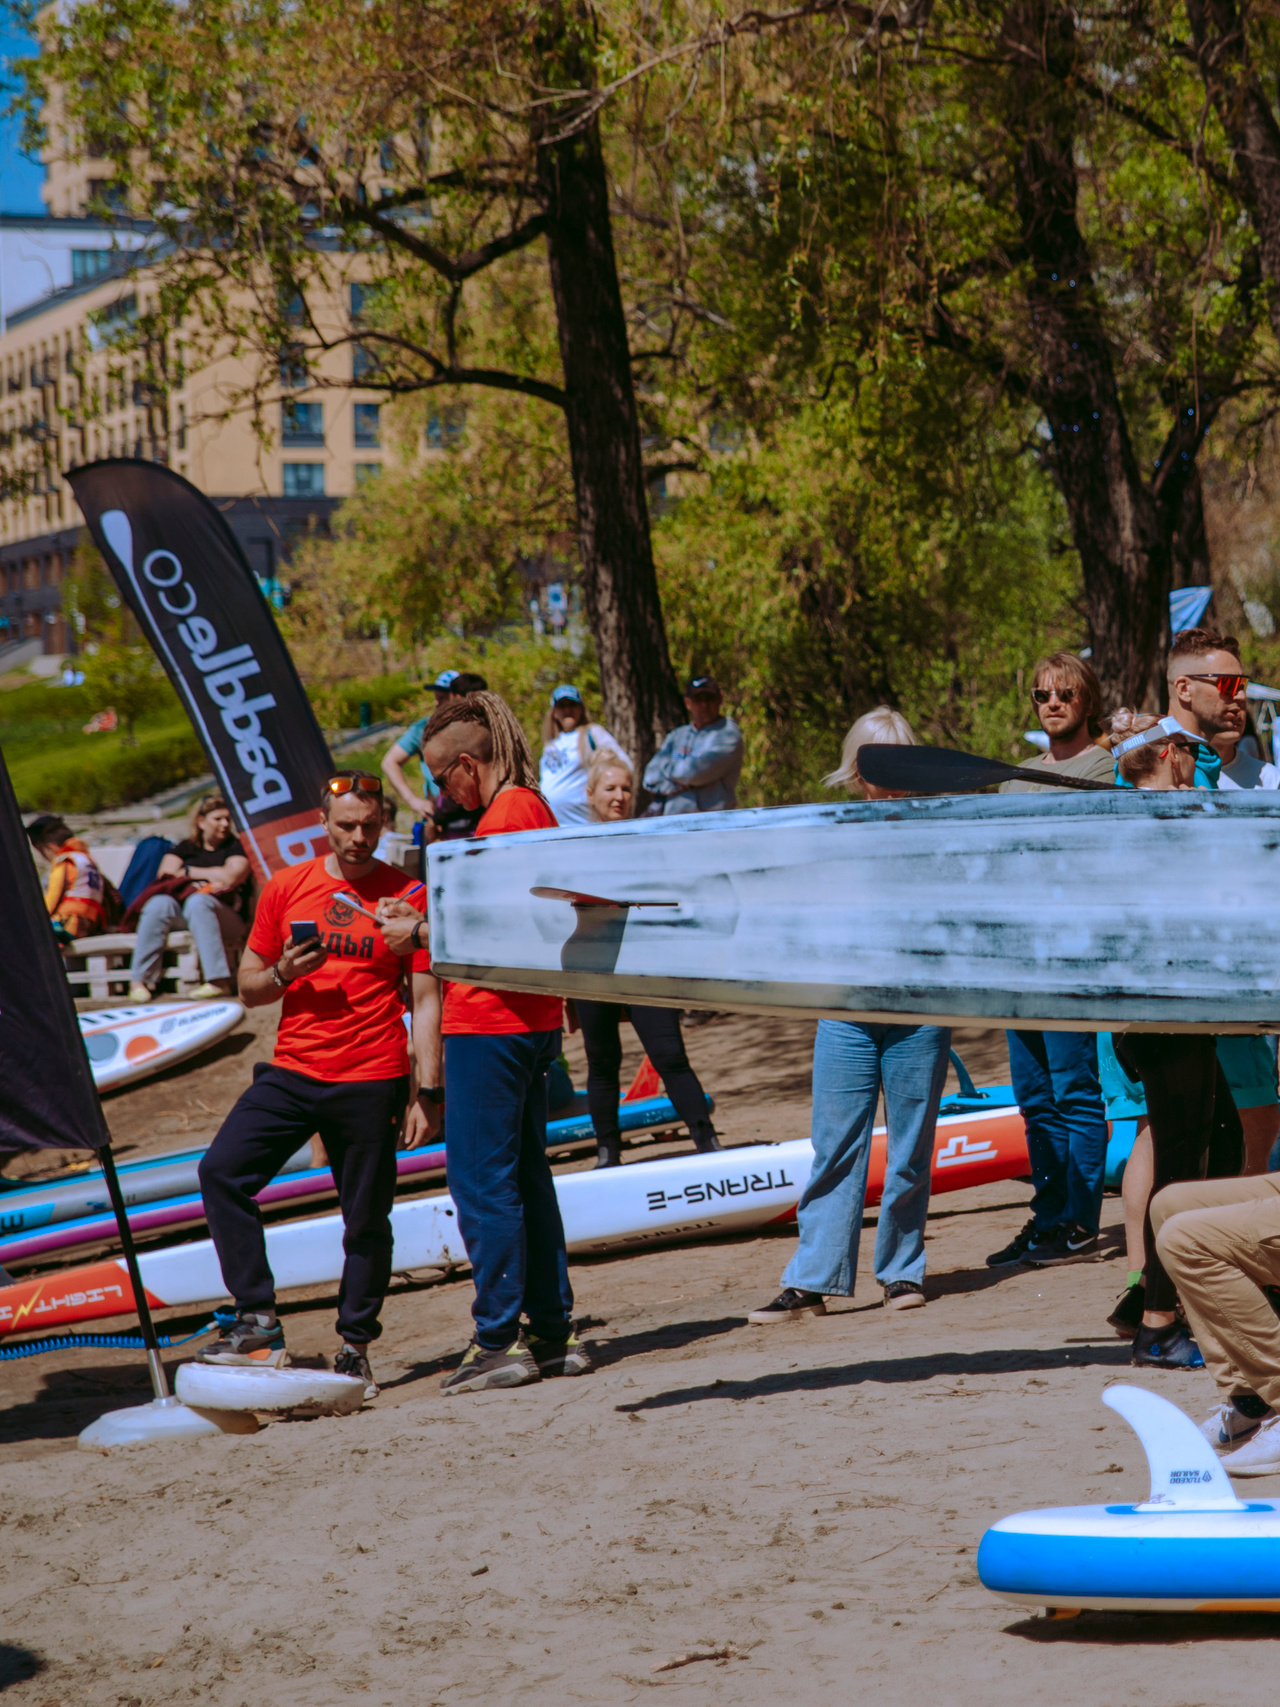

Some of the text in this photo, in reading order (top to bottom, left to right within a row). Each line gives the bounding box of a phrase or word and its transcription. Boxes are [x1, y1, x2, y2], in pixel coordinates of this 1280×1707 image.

[1122, 734, 1146, 751] PUMA
[319, 931, 375, 958] ДЬЯ
[646, 1169, 794, 1211] TRANS-E
[1170, 1470, 1200, 1478] SAILOR
